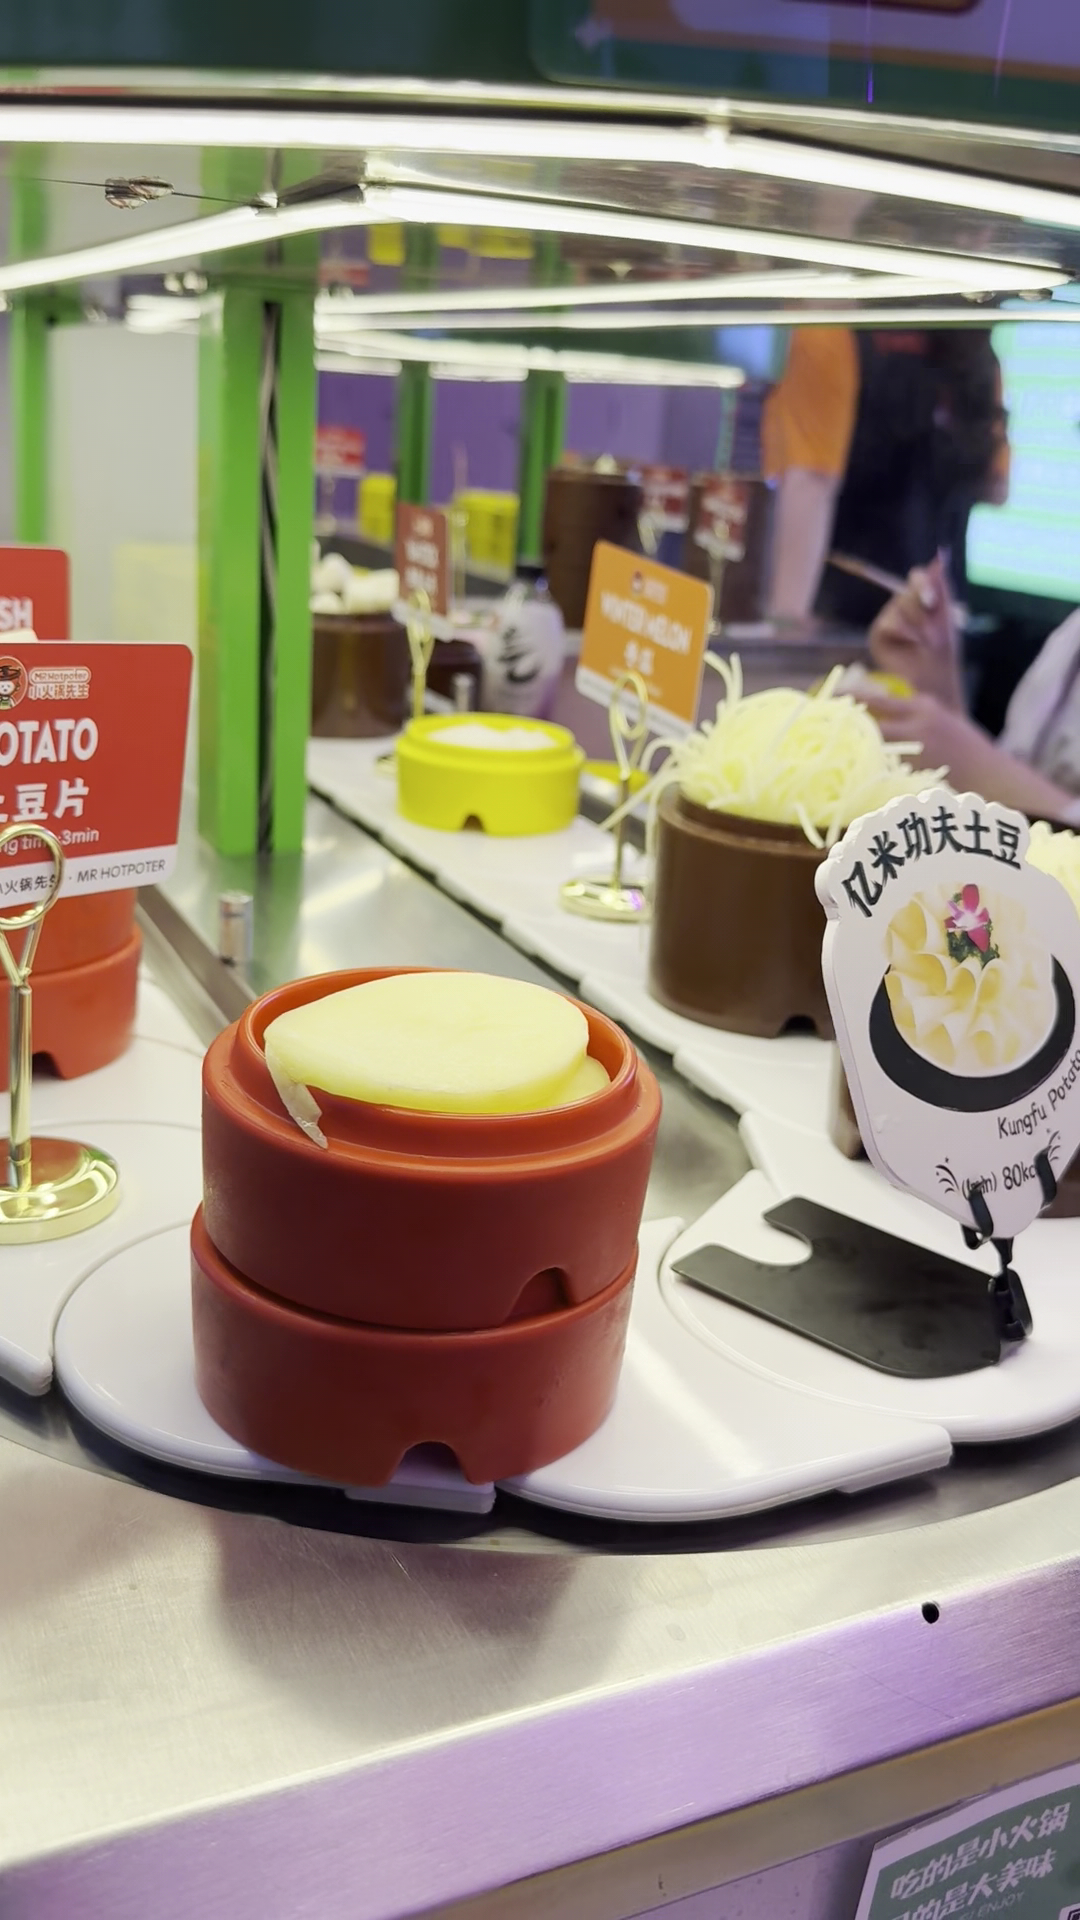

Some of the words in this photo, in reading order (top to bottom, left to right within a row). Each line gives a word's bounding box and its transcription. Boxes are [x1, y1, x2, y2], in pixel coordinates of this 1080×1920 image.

[77, 869, 98, 883] MR
[101, 859, 166, 879] HOTPOTER
[842, 806, 1020, 918] 亿米功夫土豆
[997, 1102, 1048, 1139] Kungfu
[890, 1802, 1071, 1900] 吃的是小火锅
[892, 1848, 1056, 1920] 的是大美味
